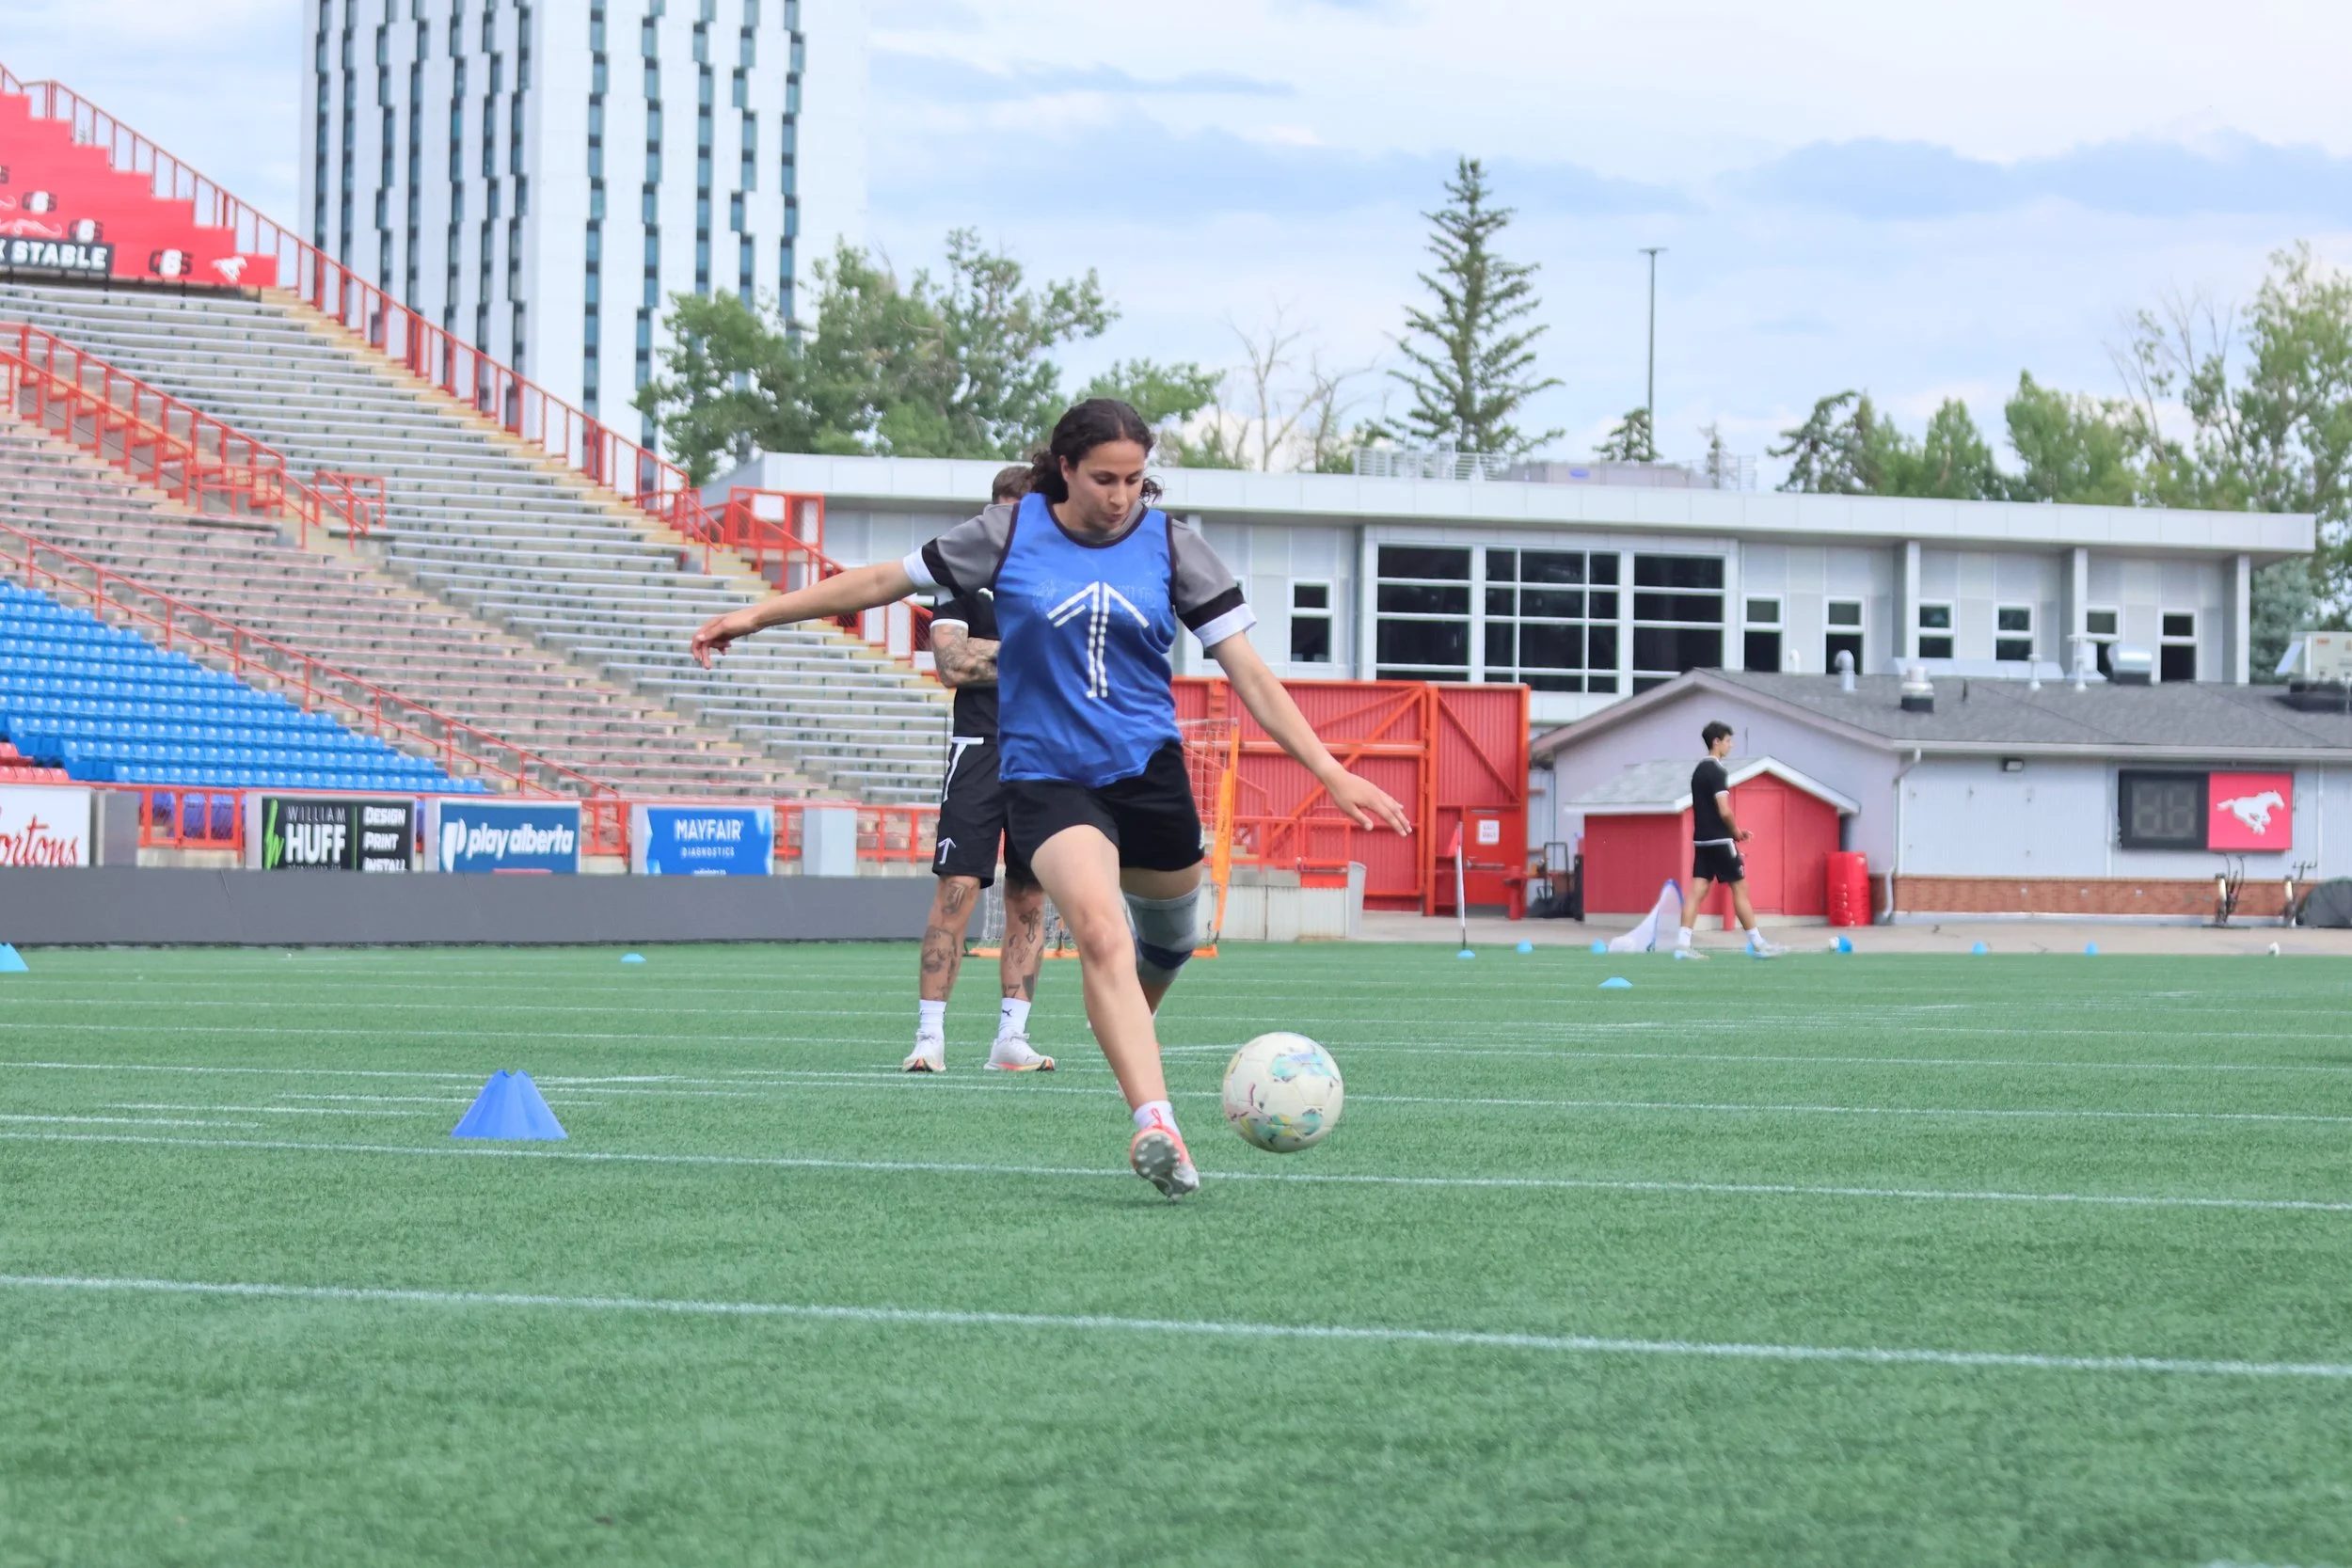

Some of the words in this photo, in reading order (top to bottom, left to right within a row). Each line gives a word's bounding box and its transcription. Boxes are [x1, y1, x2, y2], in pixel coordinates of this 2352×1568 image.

[10, 240, 108, 271] STABLE
[285, 805, 346, 823] WILLIAM
[363, 806, 406, 828] DESIGN
[0, 806, 79, 866] ortons
[362, 832, 400, 851] PRINT
[674, 818, 742, 843] MAYFAIR
[284, 823, 347, 864] HUFF
[681, 847, 735, 860] DIAGNOSTICS
